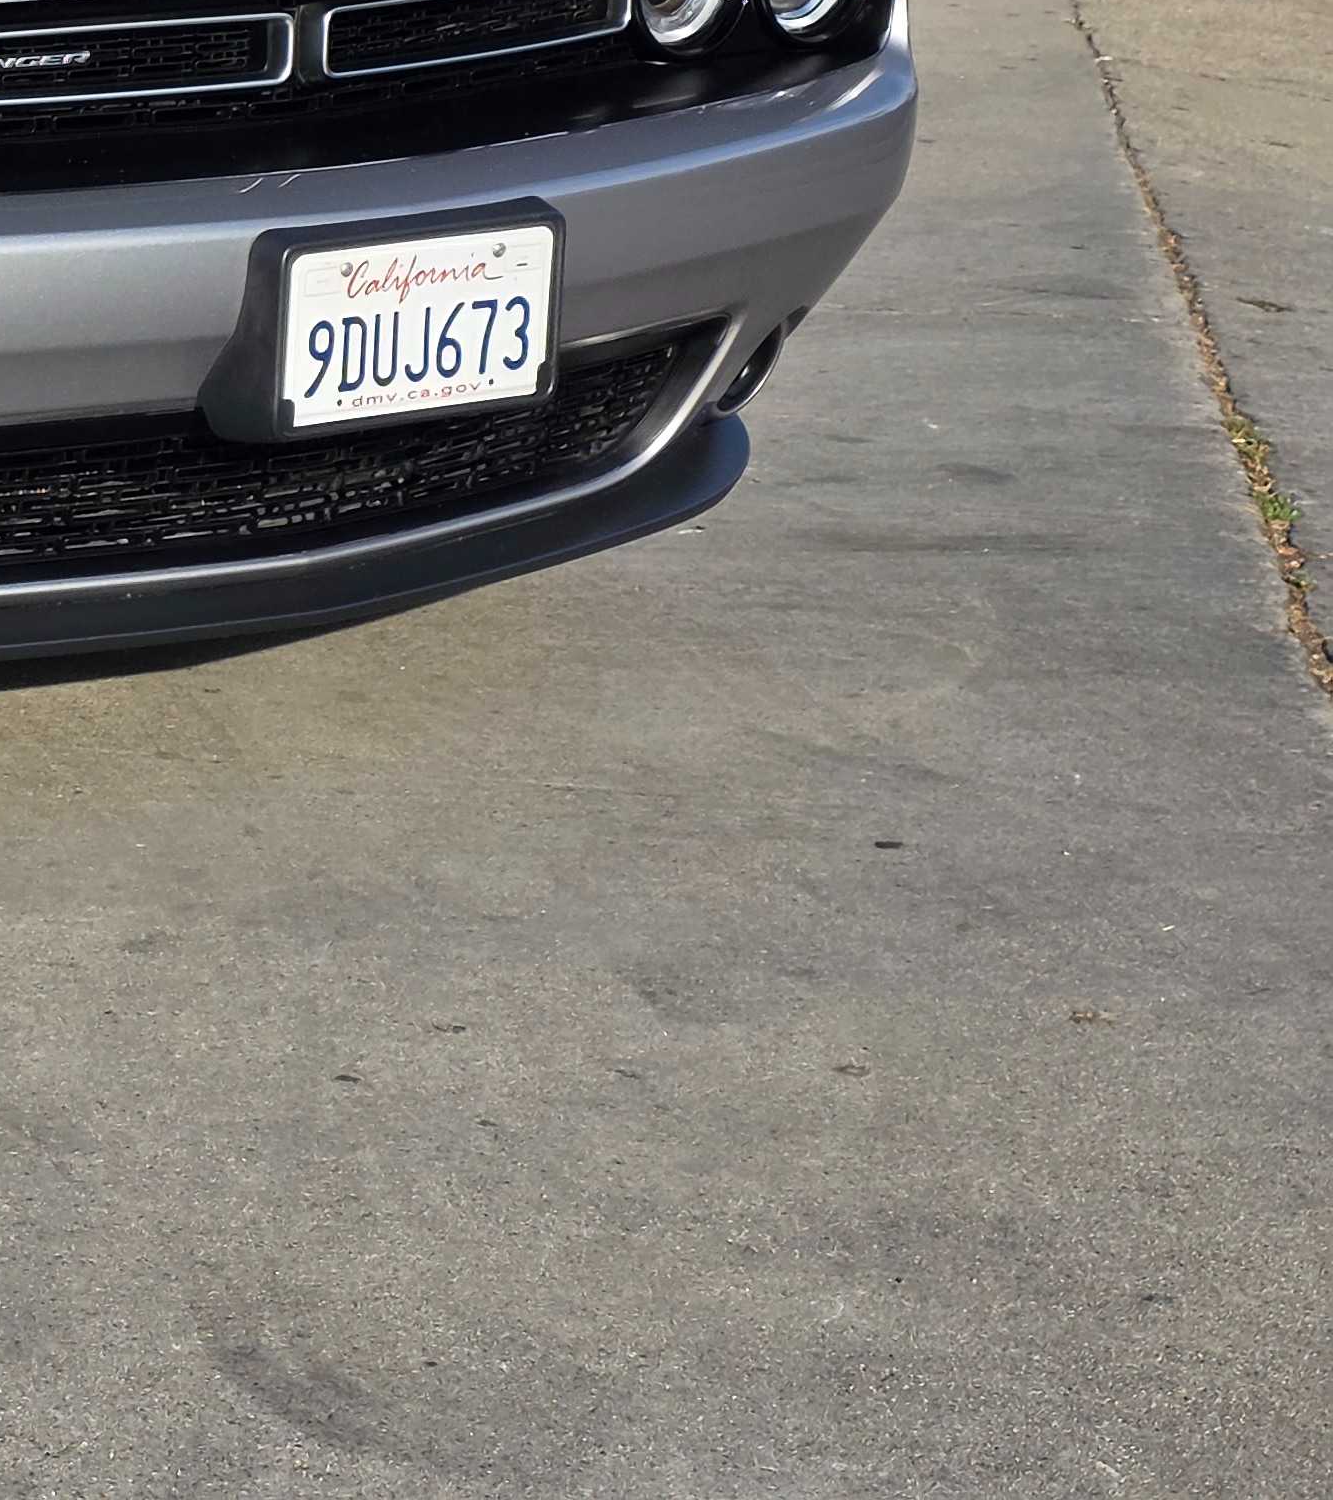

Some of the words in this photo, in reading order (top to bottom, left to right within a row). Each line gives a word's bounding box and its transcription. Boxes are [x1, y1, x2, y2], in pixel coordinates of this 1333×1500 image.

[346, 253, 503, 304] California
[304, 295, 531, 399] 9DUJ673
[351, 379, 482, 408] dmv.ca.gov
